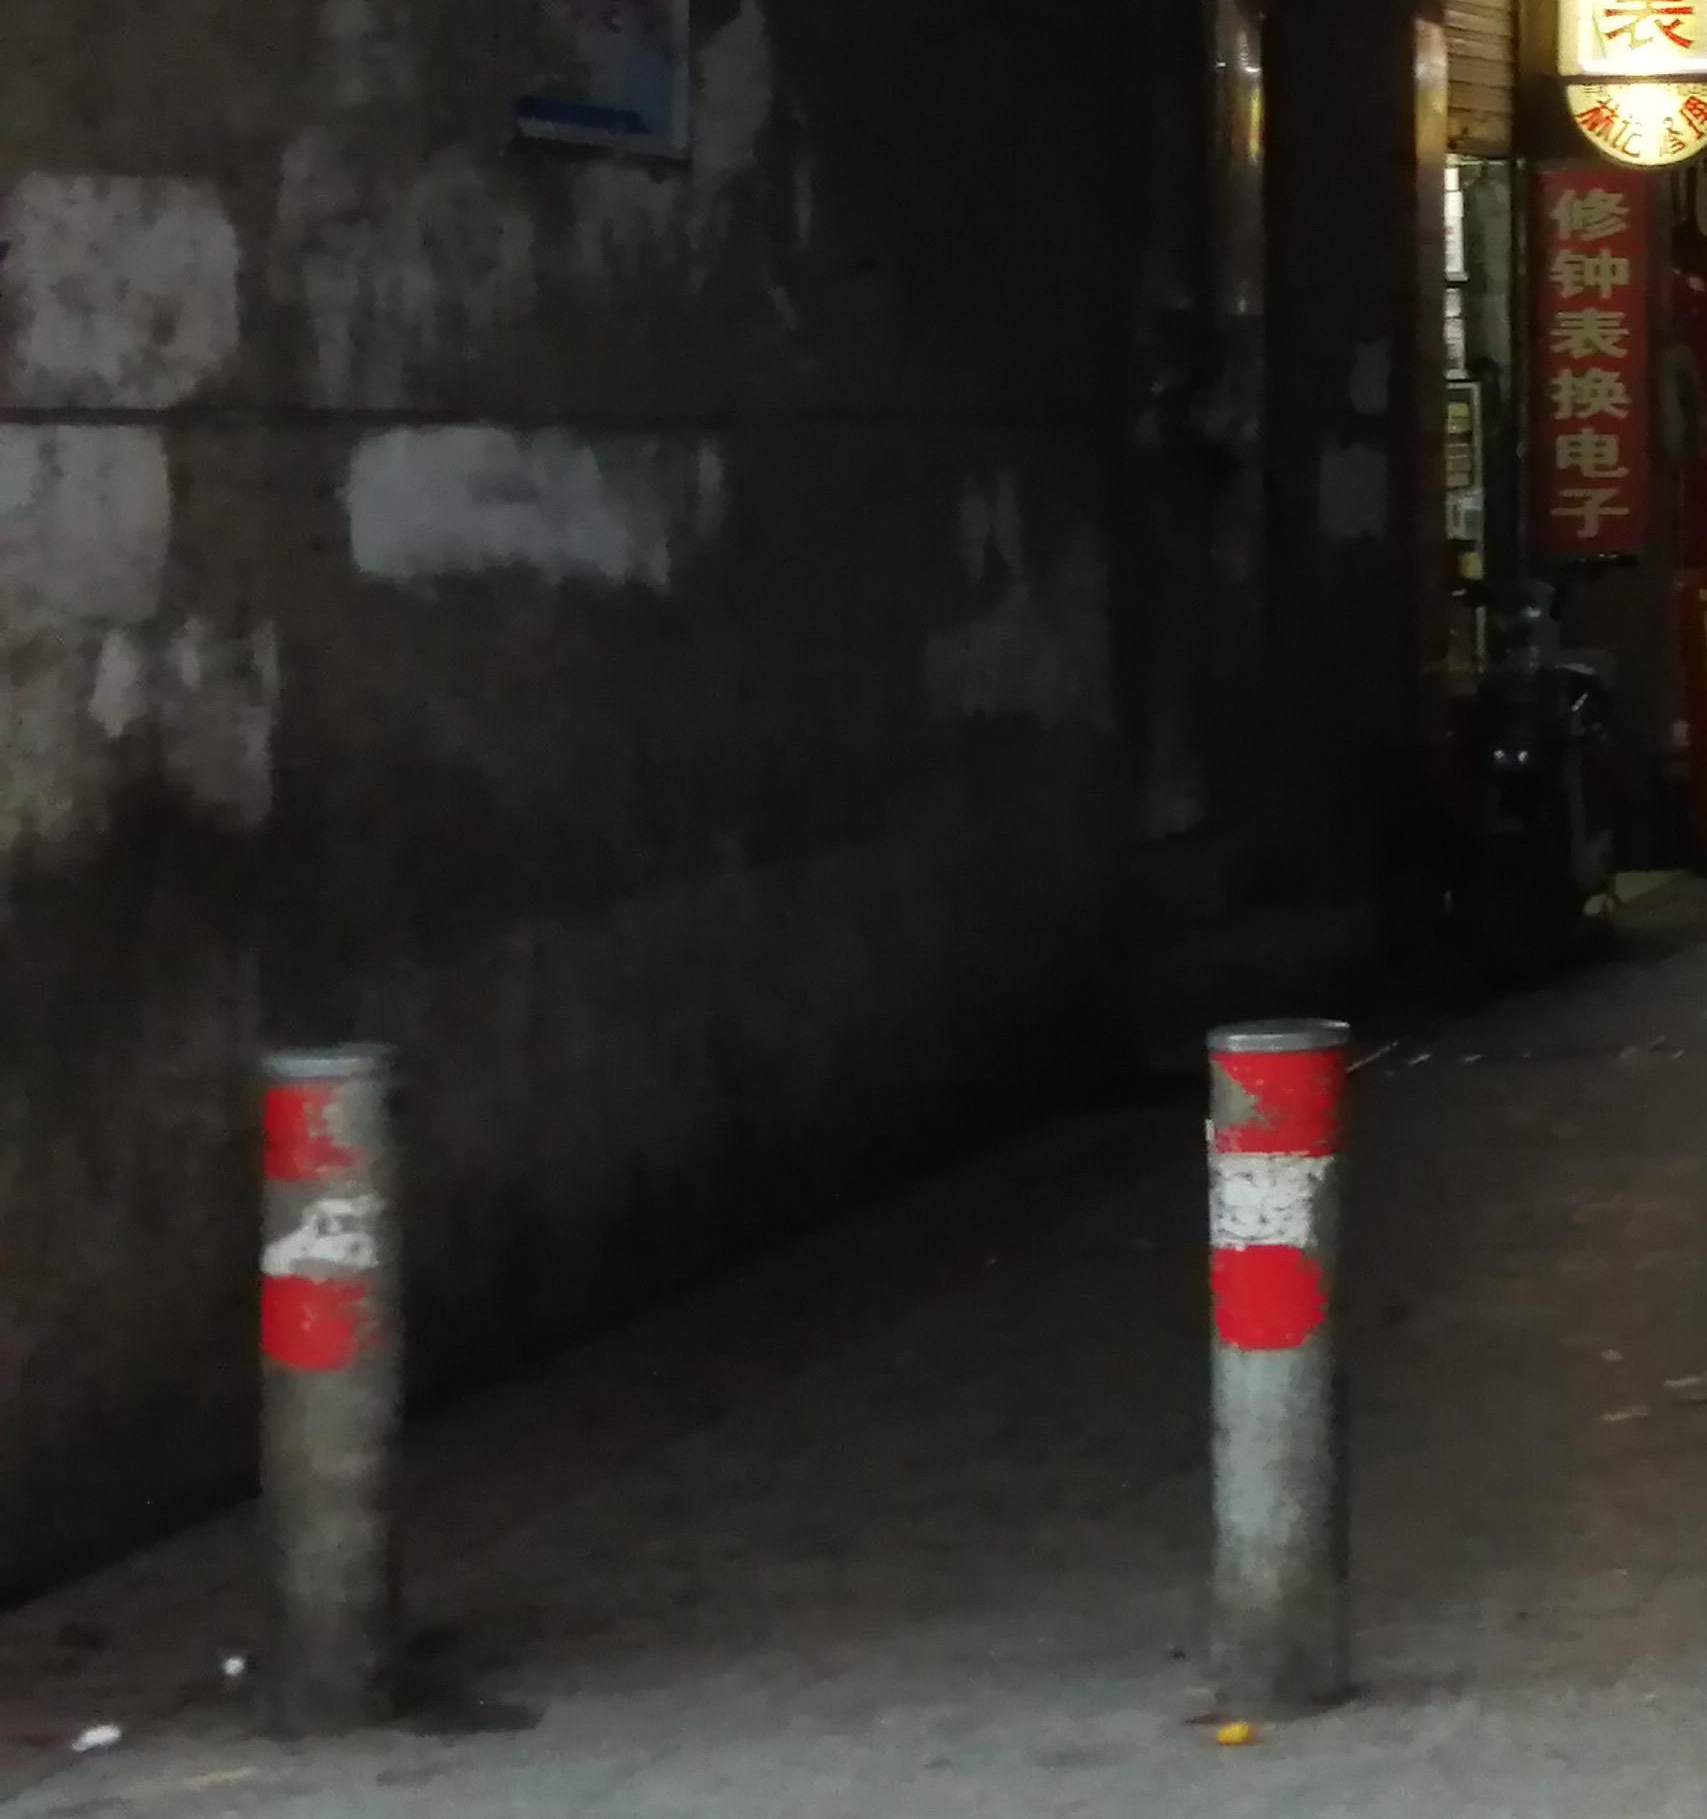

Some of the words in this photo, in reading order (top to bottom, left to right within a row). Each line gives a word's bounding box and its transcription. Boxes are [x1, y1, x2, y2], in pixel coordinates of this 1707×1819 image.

[1549, 186, 1632, 539] 修钟表换电子
